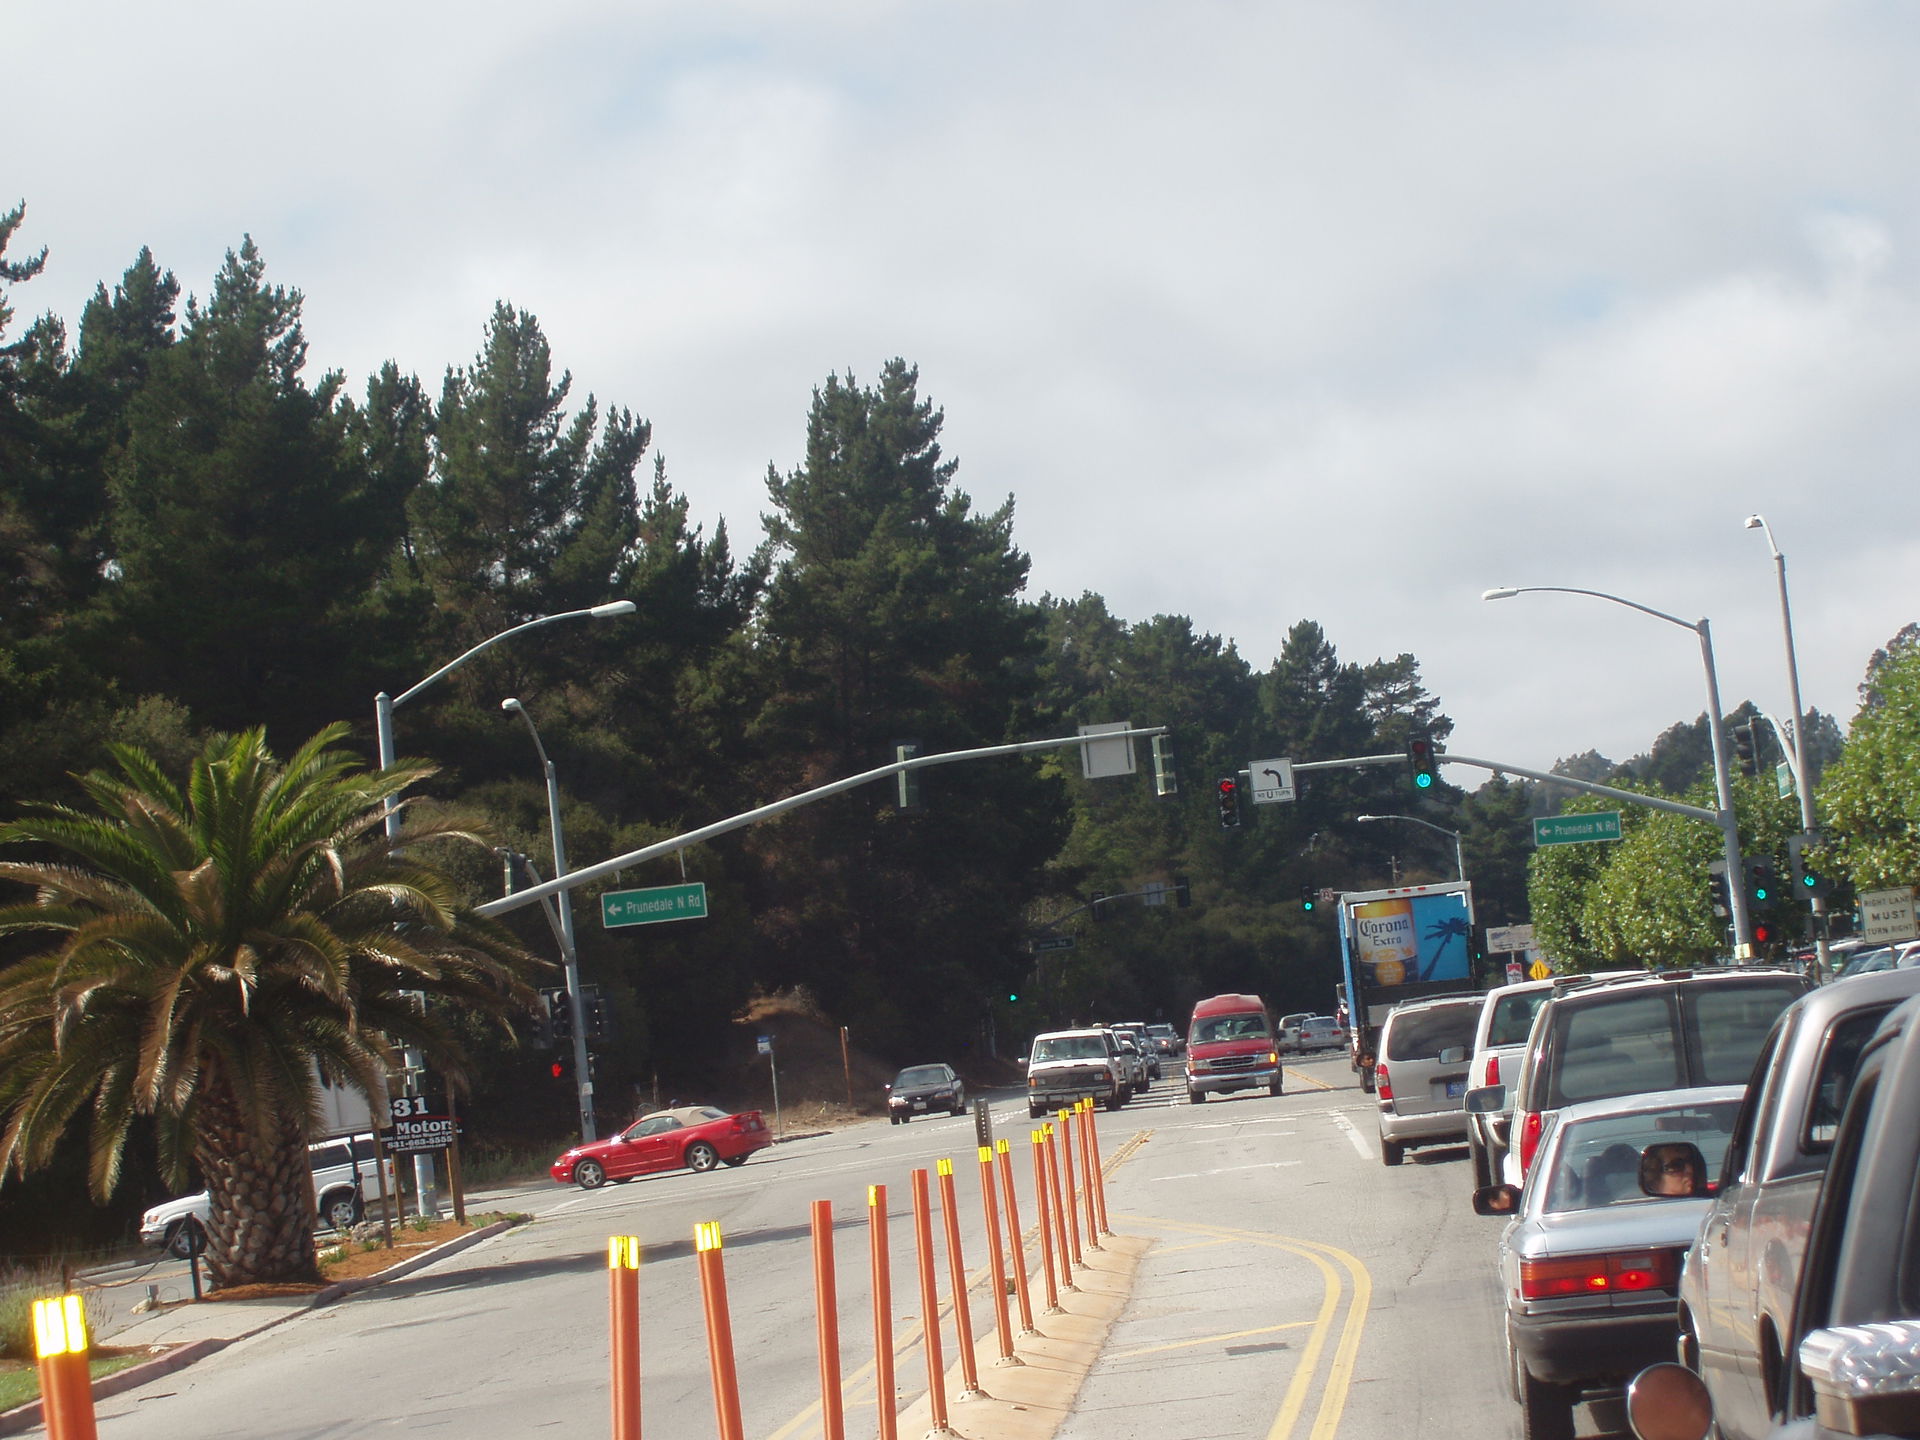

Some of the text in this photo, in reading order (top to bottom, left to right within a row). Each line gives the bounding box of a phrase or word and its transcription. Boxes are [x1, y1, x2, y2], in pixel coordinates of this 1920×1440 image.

[1266, 791, 1274, 799] U
[1554, 820, 1616, 835] Prunedale N Rd
[626, 894, 701, 914] Prunedale N Rd
[1863, 898, 1886, 907] RIGHT
[1871, 910, 1905, 921] MUST
[1360, 919, 1409, 938] Corona
[1867, 923, 1913, 936] TURN RIGHT
[1373, 935, 1402, 946] Extra
[390, 1097, 429, 1117] 31
